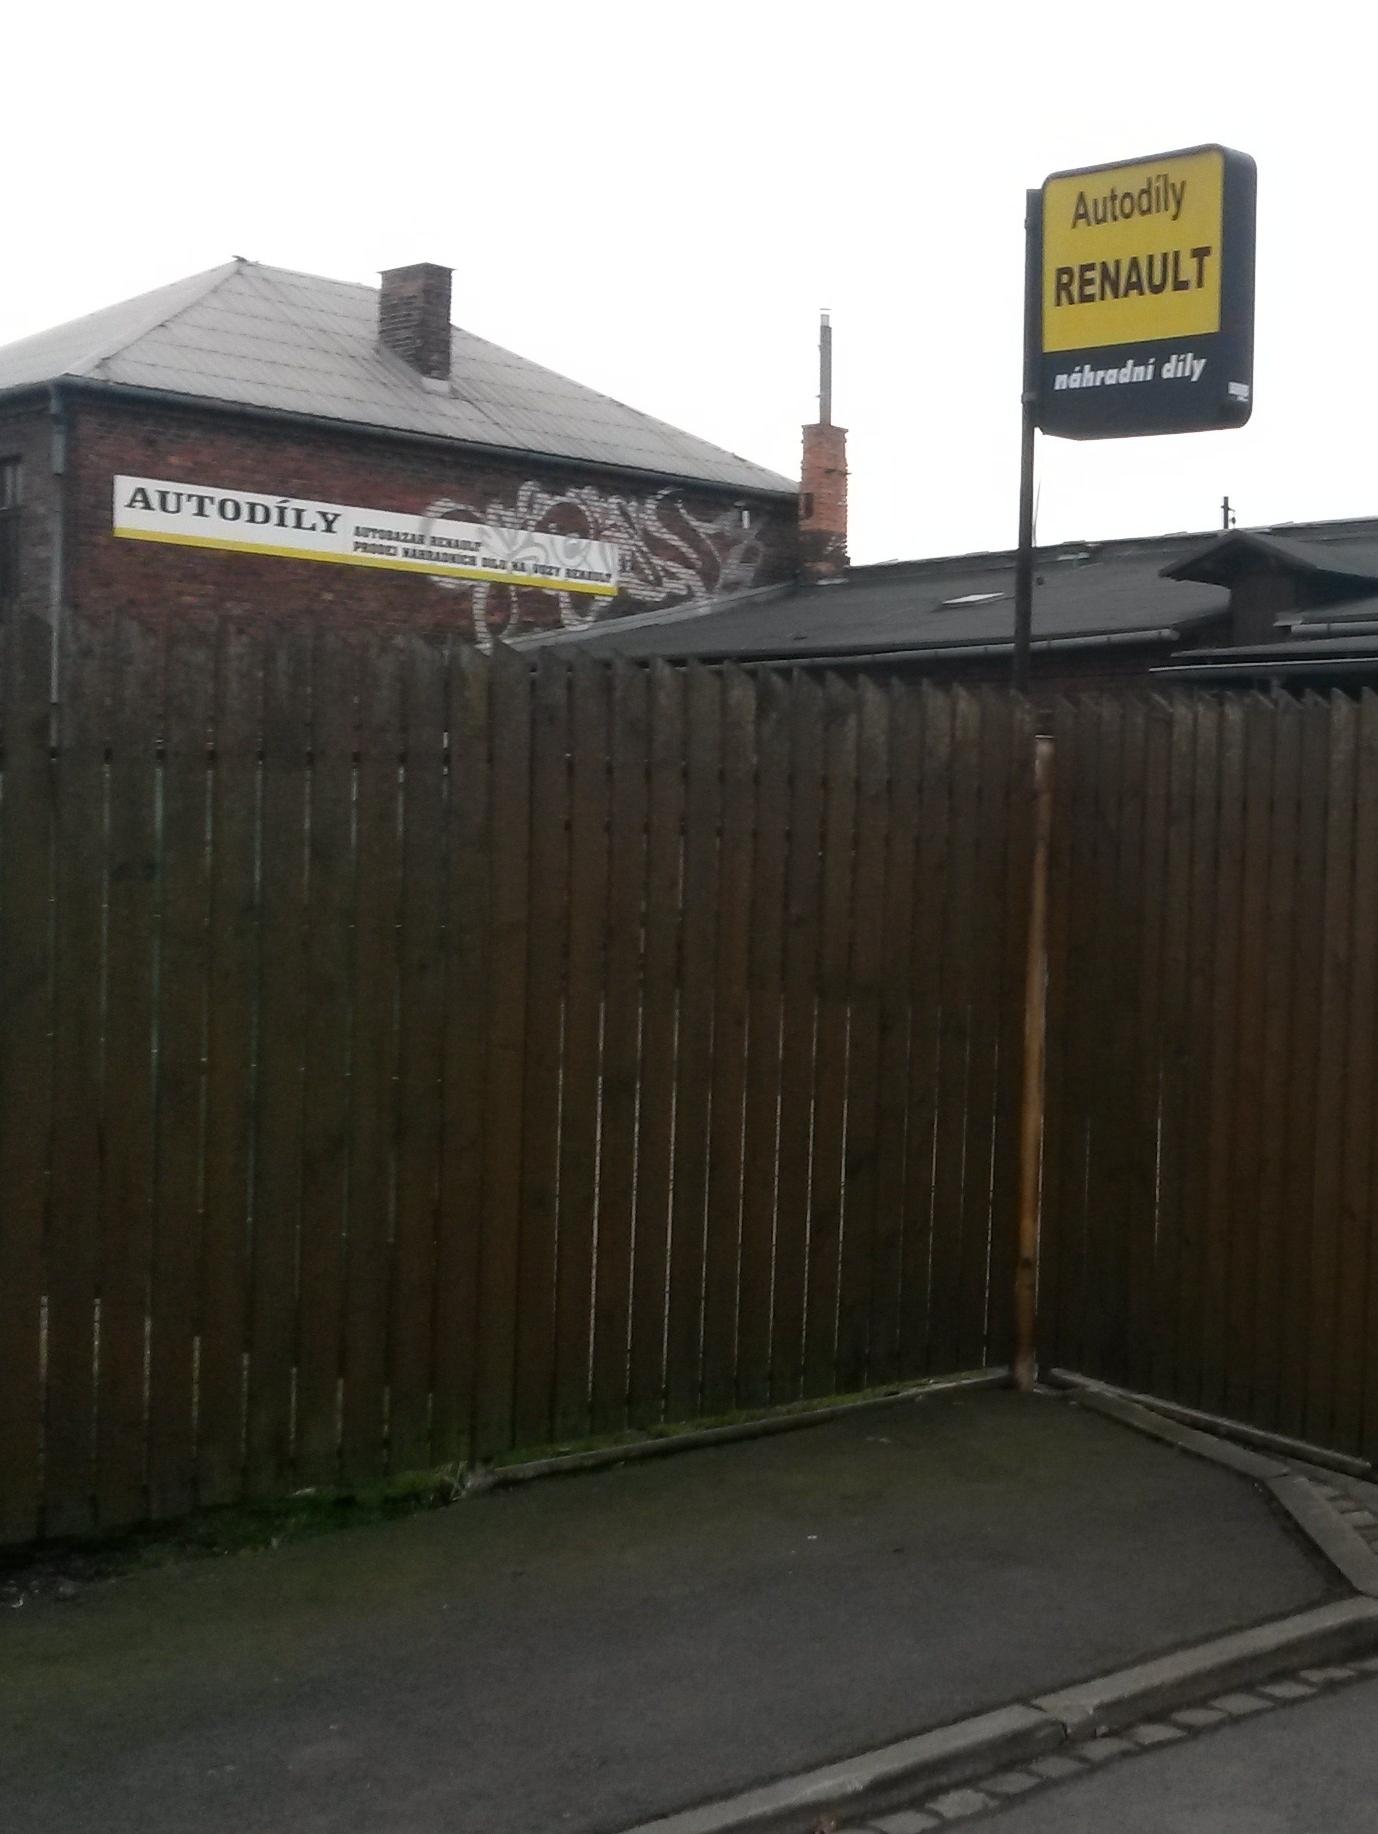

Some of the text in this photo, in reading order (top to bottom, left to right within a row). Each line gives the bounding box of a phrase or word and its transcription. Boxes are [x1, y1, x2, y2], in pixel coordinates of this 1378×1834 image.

[1071, 173, 1186, 229] Autodíly
[1054, 246, 1212, 307] RENAULT
[1053, 353, 1207, 391] náhradní díly
[124, 487, 342, 534] AUTODÍLY
